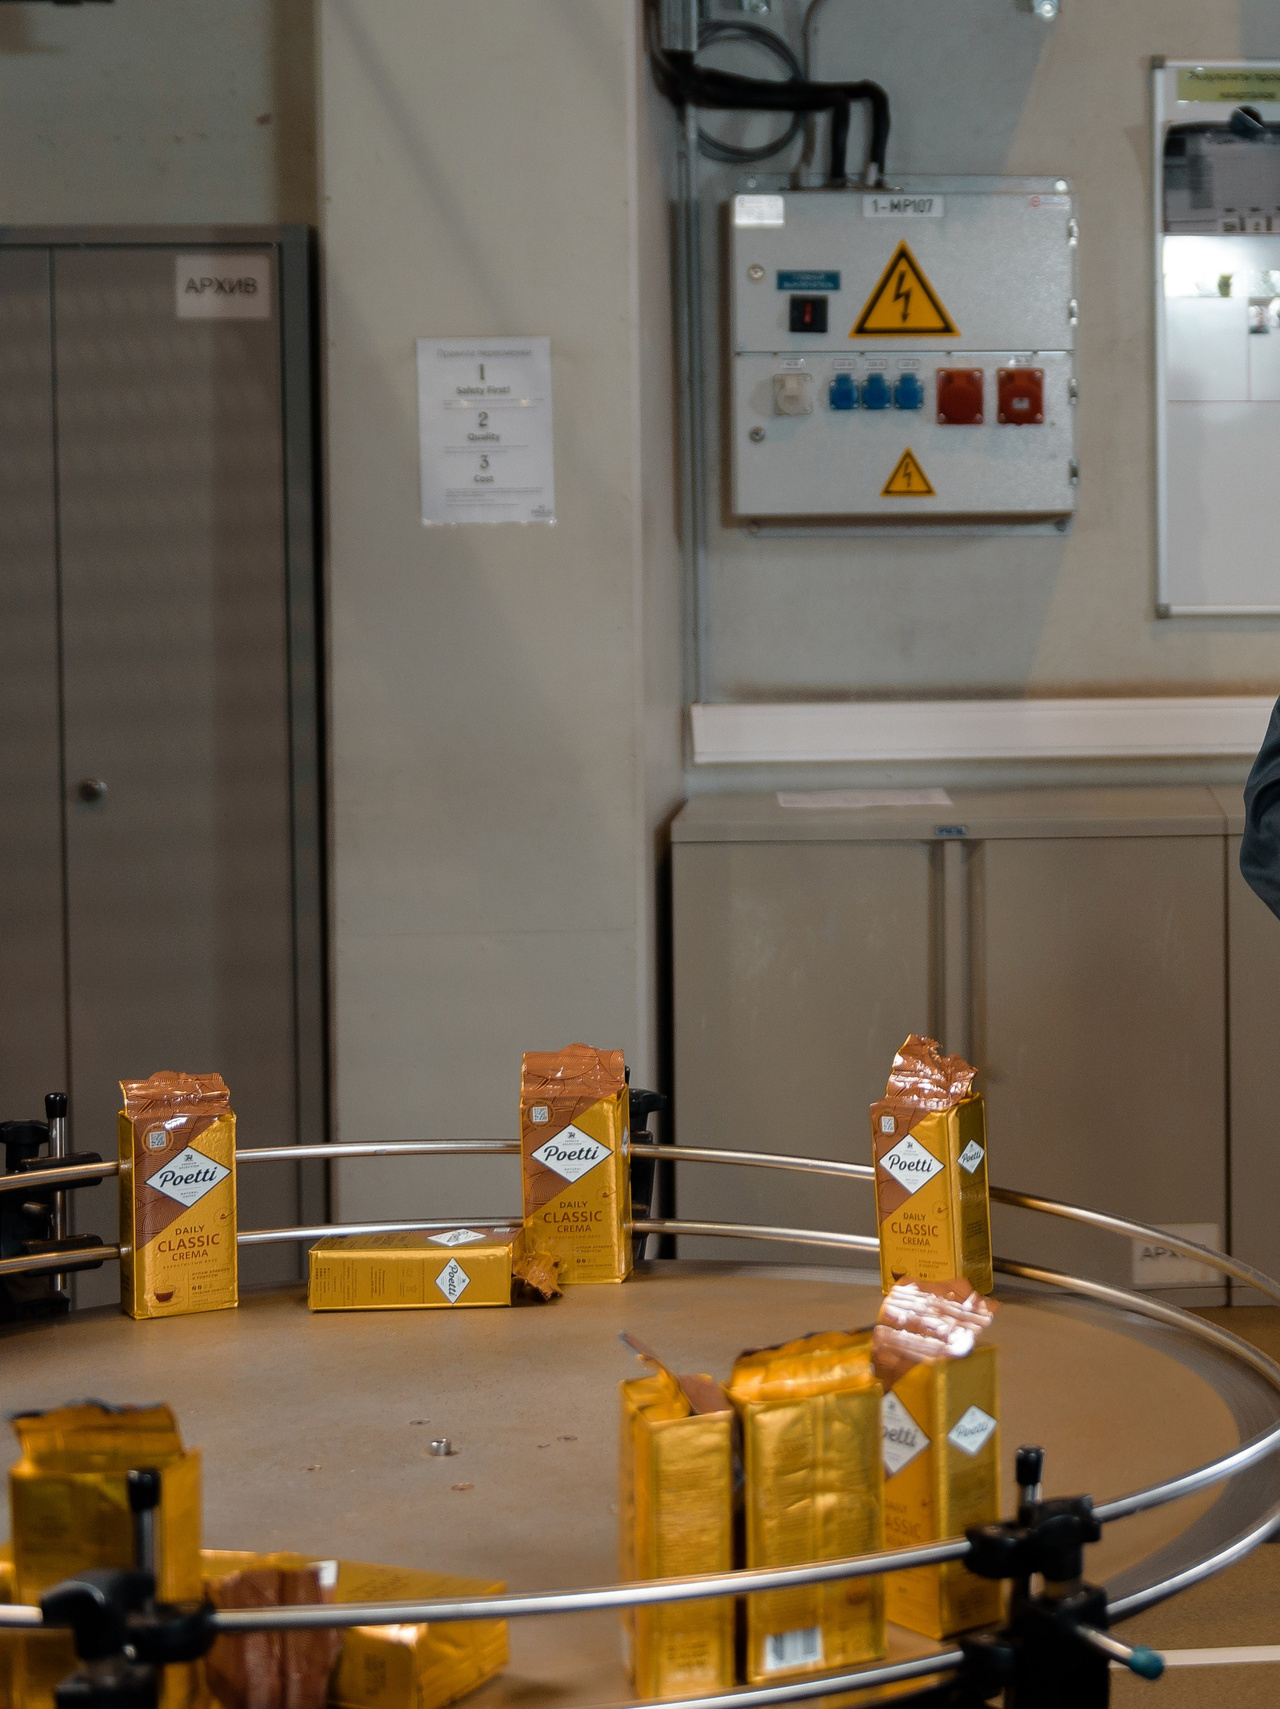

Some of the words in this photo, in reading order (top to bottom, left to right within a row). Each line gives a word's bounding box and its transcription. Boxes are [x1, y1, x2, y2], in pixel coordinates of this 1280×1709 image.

[185, 277, 258, 295] АРХИВ
[456, 386, 484, 395] Safety
[478, 411, 488, 427] 2
[467, 431, 500, 442] Quality
[480, 454, 490, 469] 3
[473, 474, 495, 483] Cost
[543, 1145, 600, 1162] Poetti
[961, 1150, 982, 1164] Poetti
[888, 1154, 933, 1173] Poetti
[159, 1166, 218, 1188] Poetti
[560, 1200, 588, 1209] DAILY
[543, 1211, 603, 1224] CLASSIC
[903, 1212, 926, 1221] DAILY
[175, 1225, 205, 1236] DAILY
[557, 1224, 592, 1233] CREMA
[891, 1222, 939, 1237] CLASSIC
[157, 1233, 220, 1253] CLASSIC
[902, 1236, 931, 1247] CREMA
[172, 1249, 209, 1261] CREMA
[447, 1263, 459, 1298] Poetti
[955, 1421, 990, 1439] Poetti
